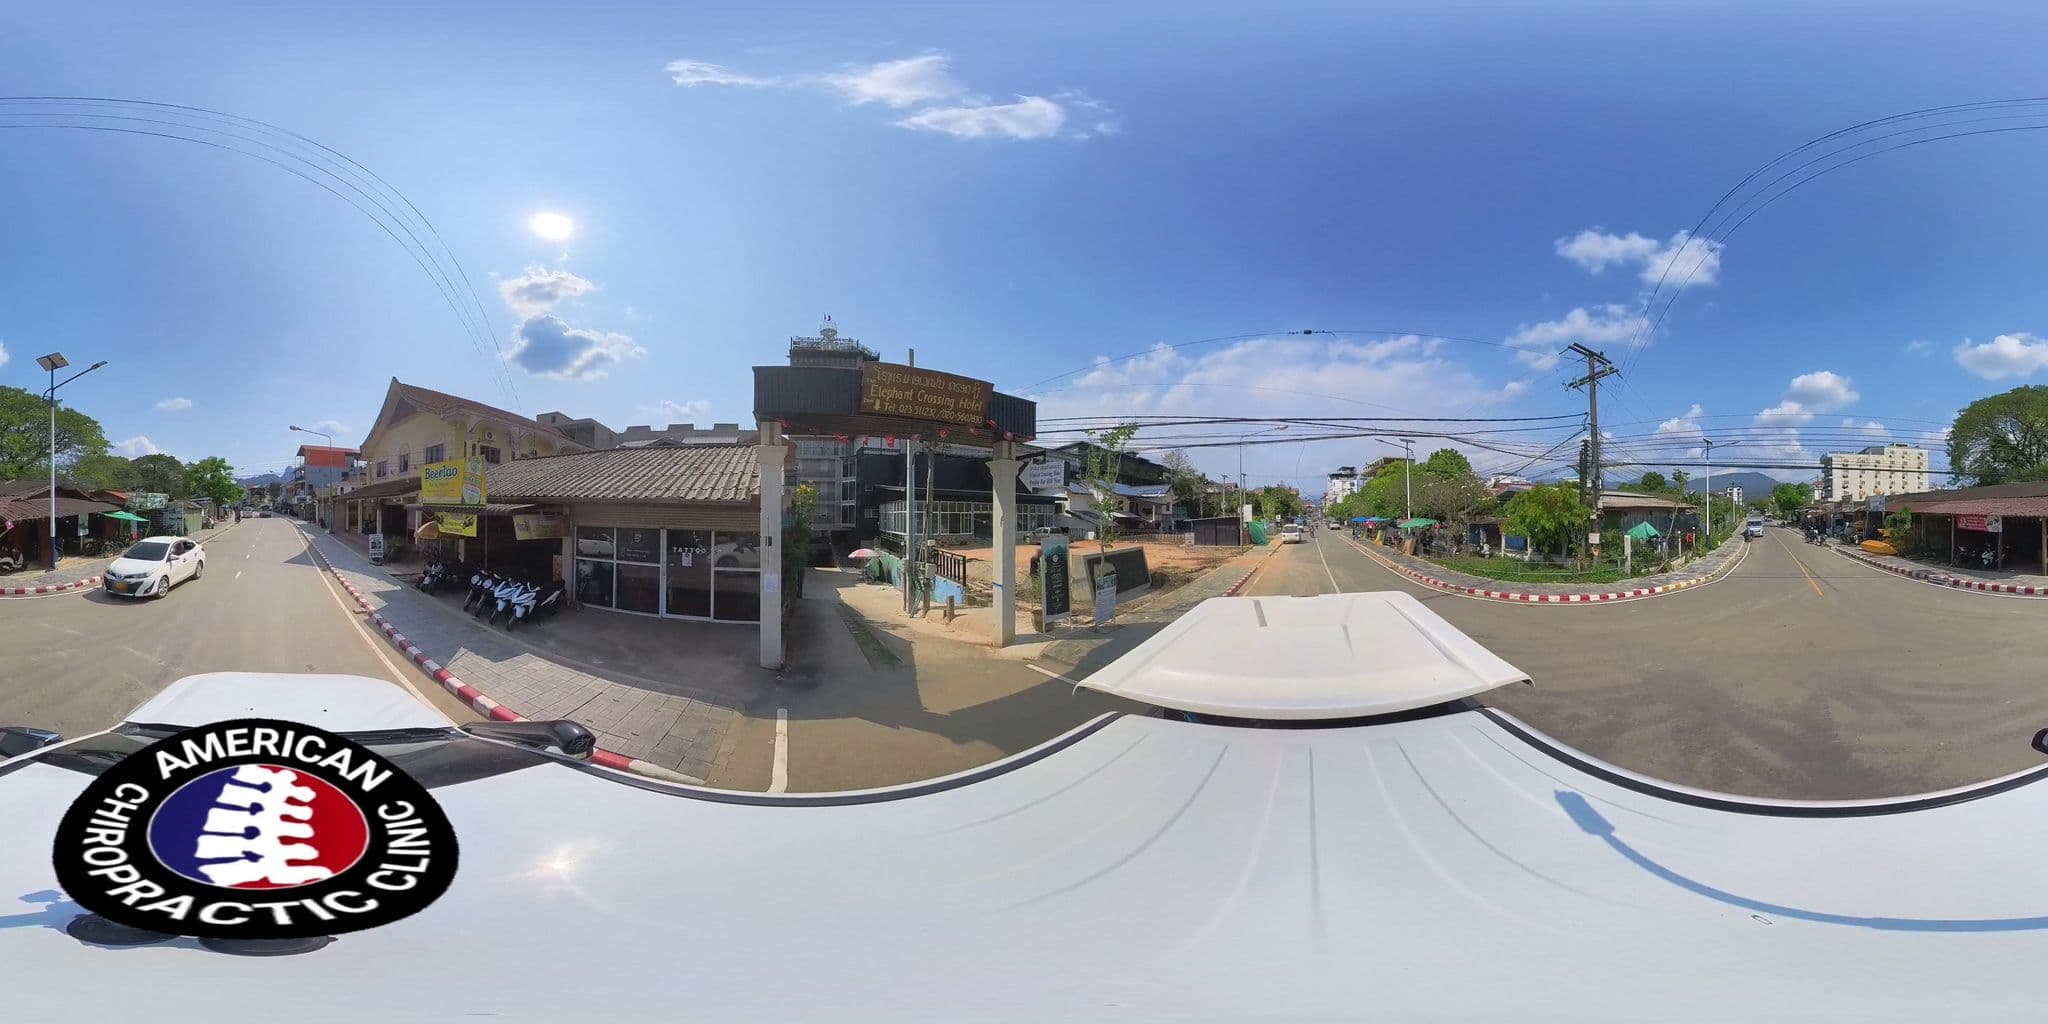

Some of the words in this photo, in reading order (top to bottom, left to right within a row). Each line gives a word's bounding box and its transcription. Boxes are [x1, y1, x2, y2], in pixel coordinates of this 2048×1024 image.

[870, 384, 914, 402] Elephant
[917, 390, 955, 410] Crossing
[959, 397, 983, 412] Hotel
[425, 465, 458, 480] Beerlao
[672, 546, 707, 554] TATTOO
